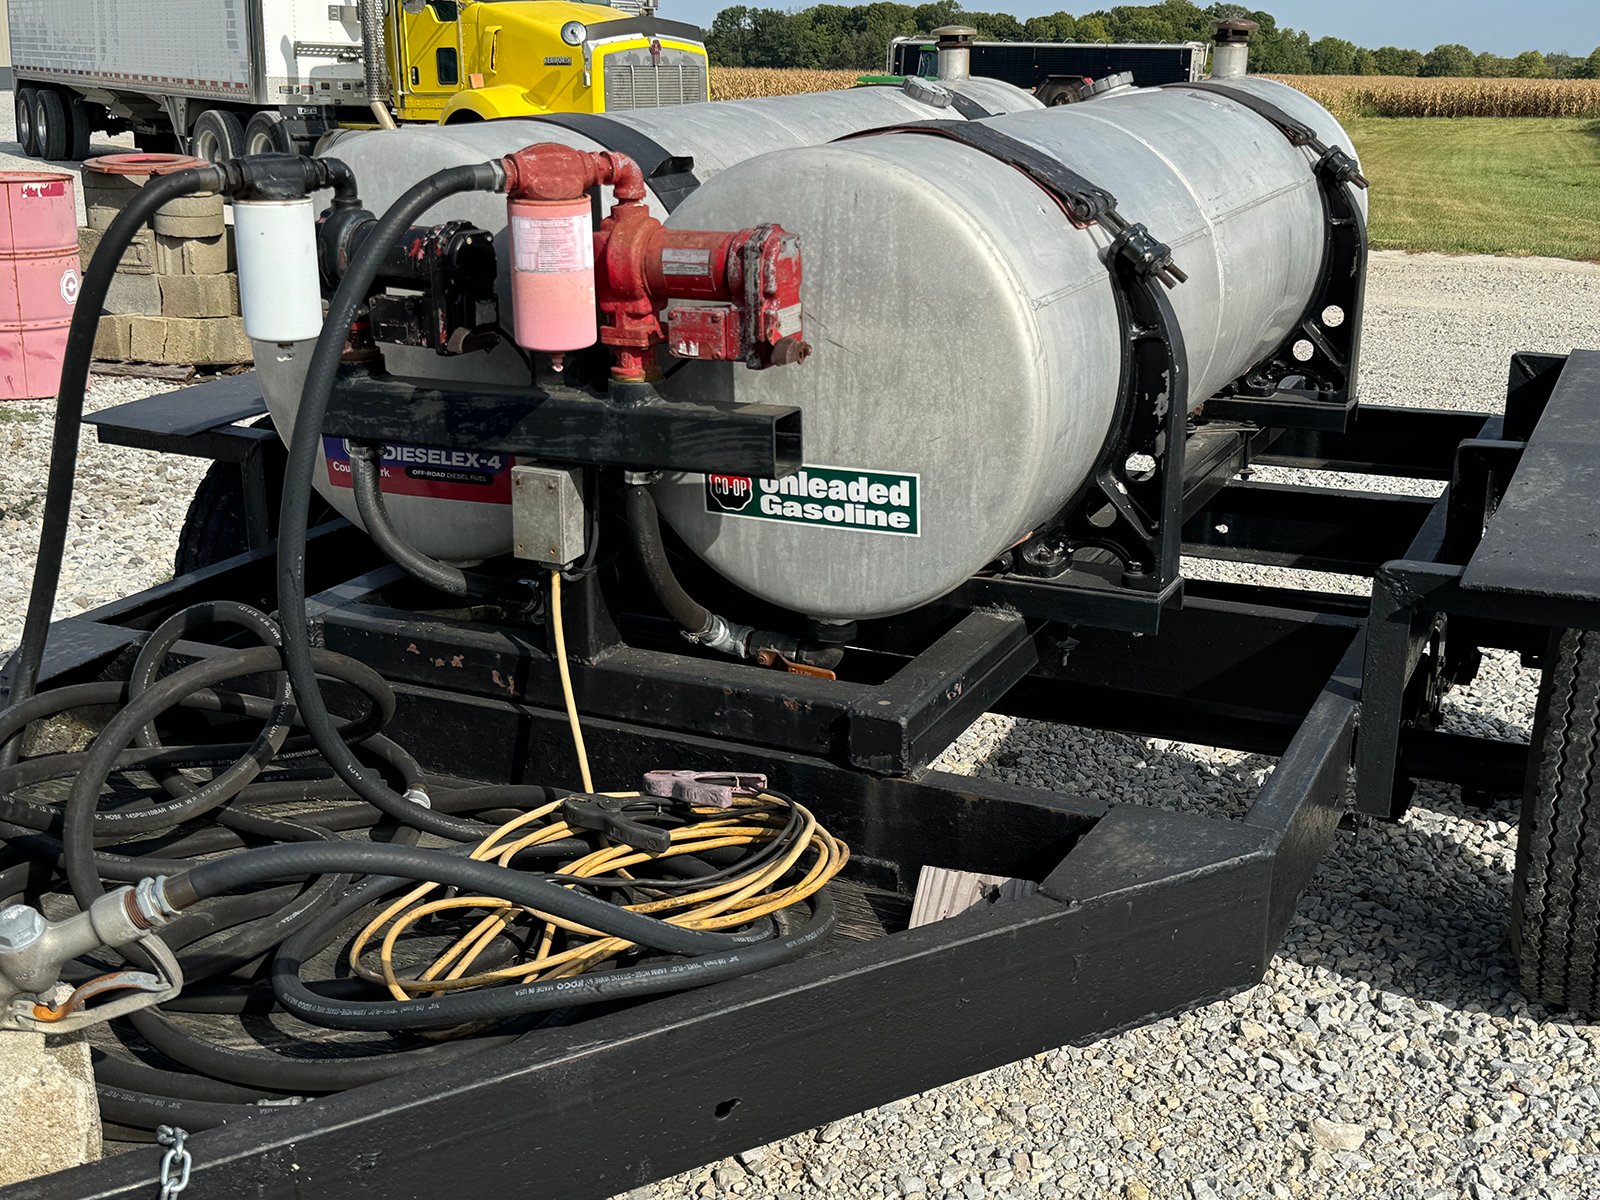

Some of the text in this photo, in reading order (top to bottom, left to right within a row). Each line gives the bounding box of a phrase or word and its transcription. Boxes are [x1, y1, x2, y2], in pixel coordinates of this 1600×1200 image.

[383, 446, 501, 469] DIESELEX-4
[412, 469, 487, 482] OFF-ROAD DIESEL FUEL
[714, 476, 747, 497] CO-OP
[759, 471, 910, 507] Unleaded
[759, 495, 910, 529] Gasoline
[169, 802, 183, 811] MAX
[536, 985, 554, 993] MADE
